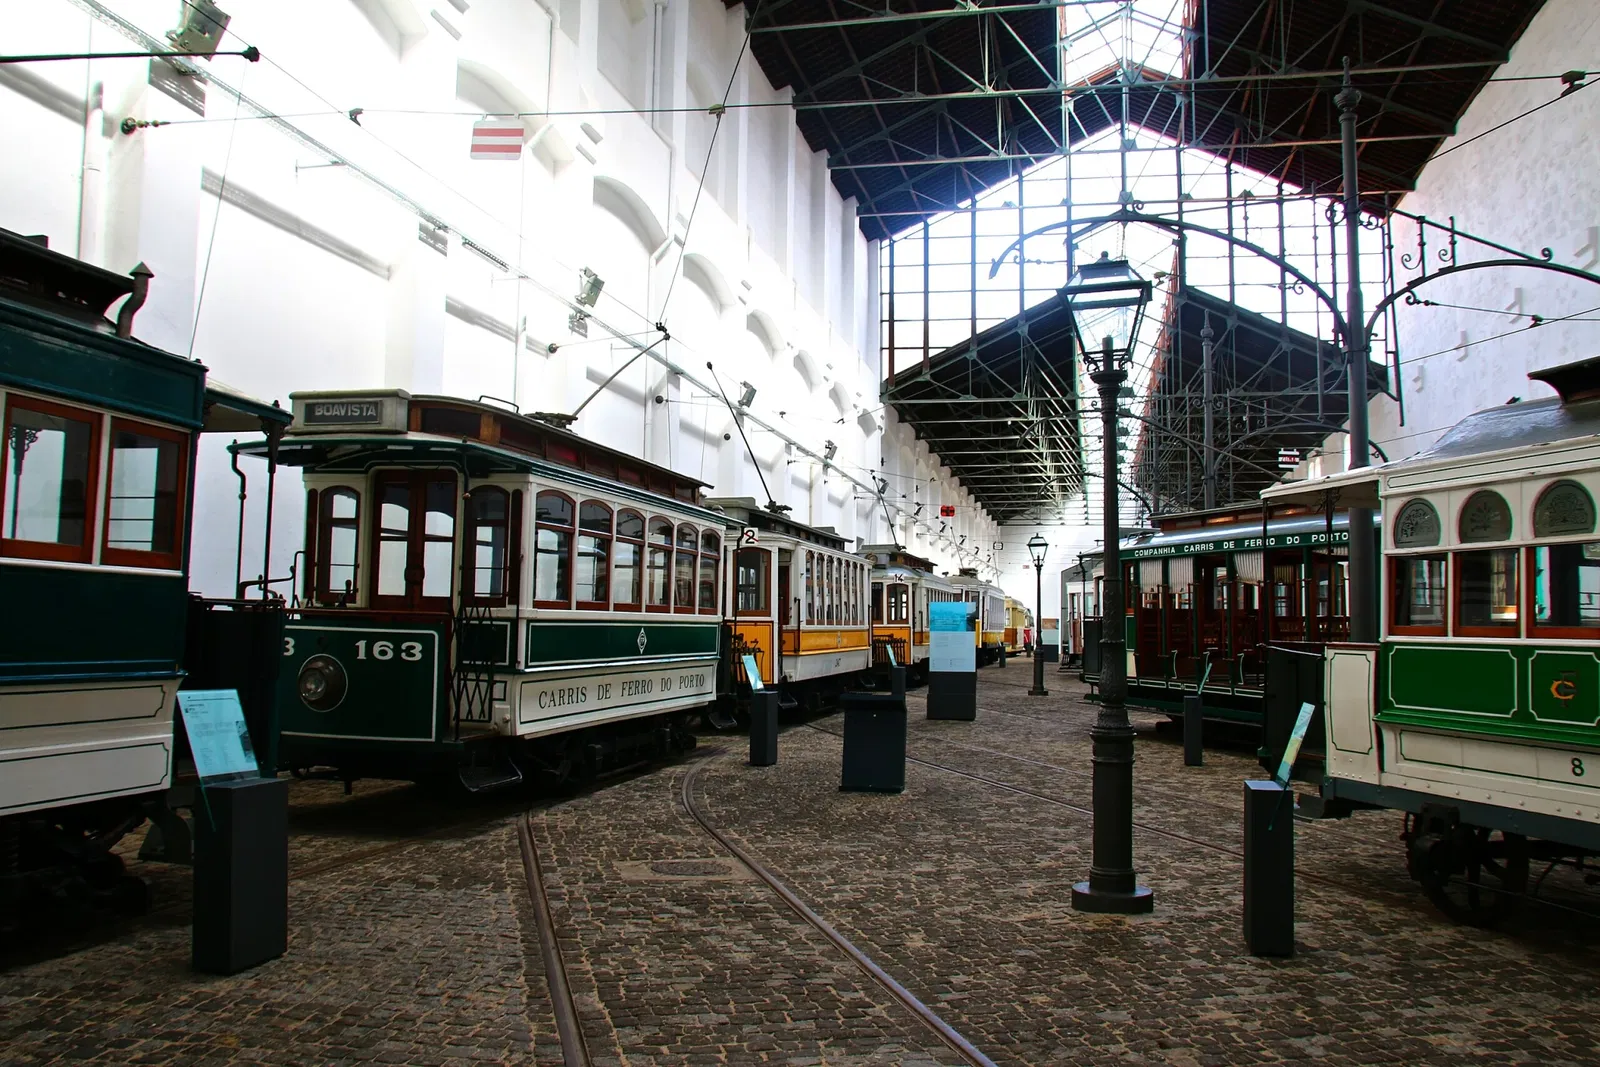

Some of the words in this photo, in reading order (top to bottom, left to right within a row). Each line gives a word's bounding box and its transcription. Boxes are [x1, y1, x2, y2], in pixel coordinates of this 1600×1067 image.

[314, 403, 377, 417] BOAVISTA
[745, 529, 755, 545] 2
[1134, 546, 1176, 557] COMPANHIA
[1183, 542, 1215, 553] CARRIS
[1223, 540, 1235, 549] DE
[1286, 535, 1300, 545] DO
[355, 639, 423, 661] 163
[538, 686, 588, 709] CARRIS
[597, 683, 612, 701] DE
[621, 679, 653, 697] FERRO
[660, 677, 672, 692] DO
[678, 673, 705, 690] PORTO
[1571, 757, 1585, 777] 8
